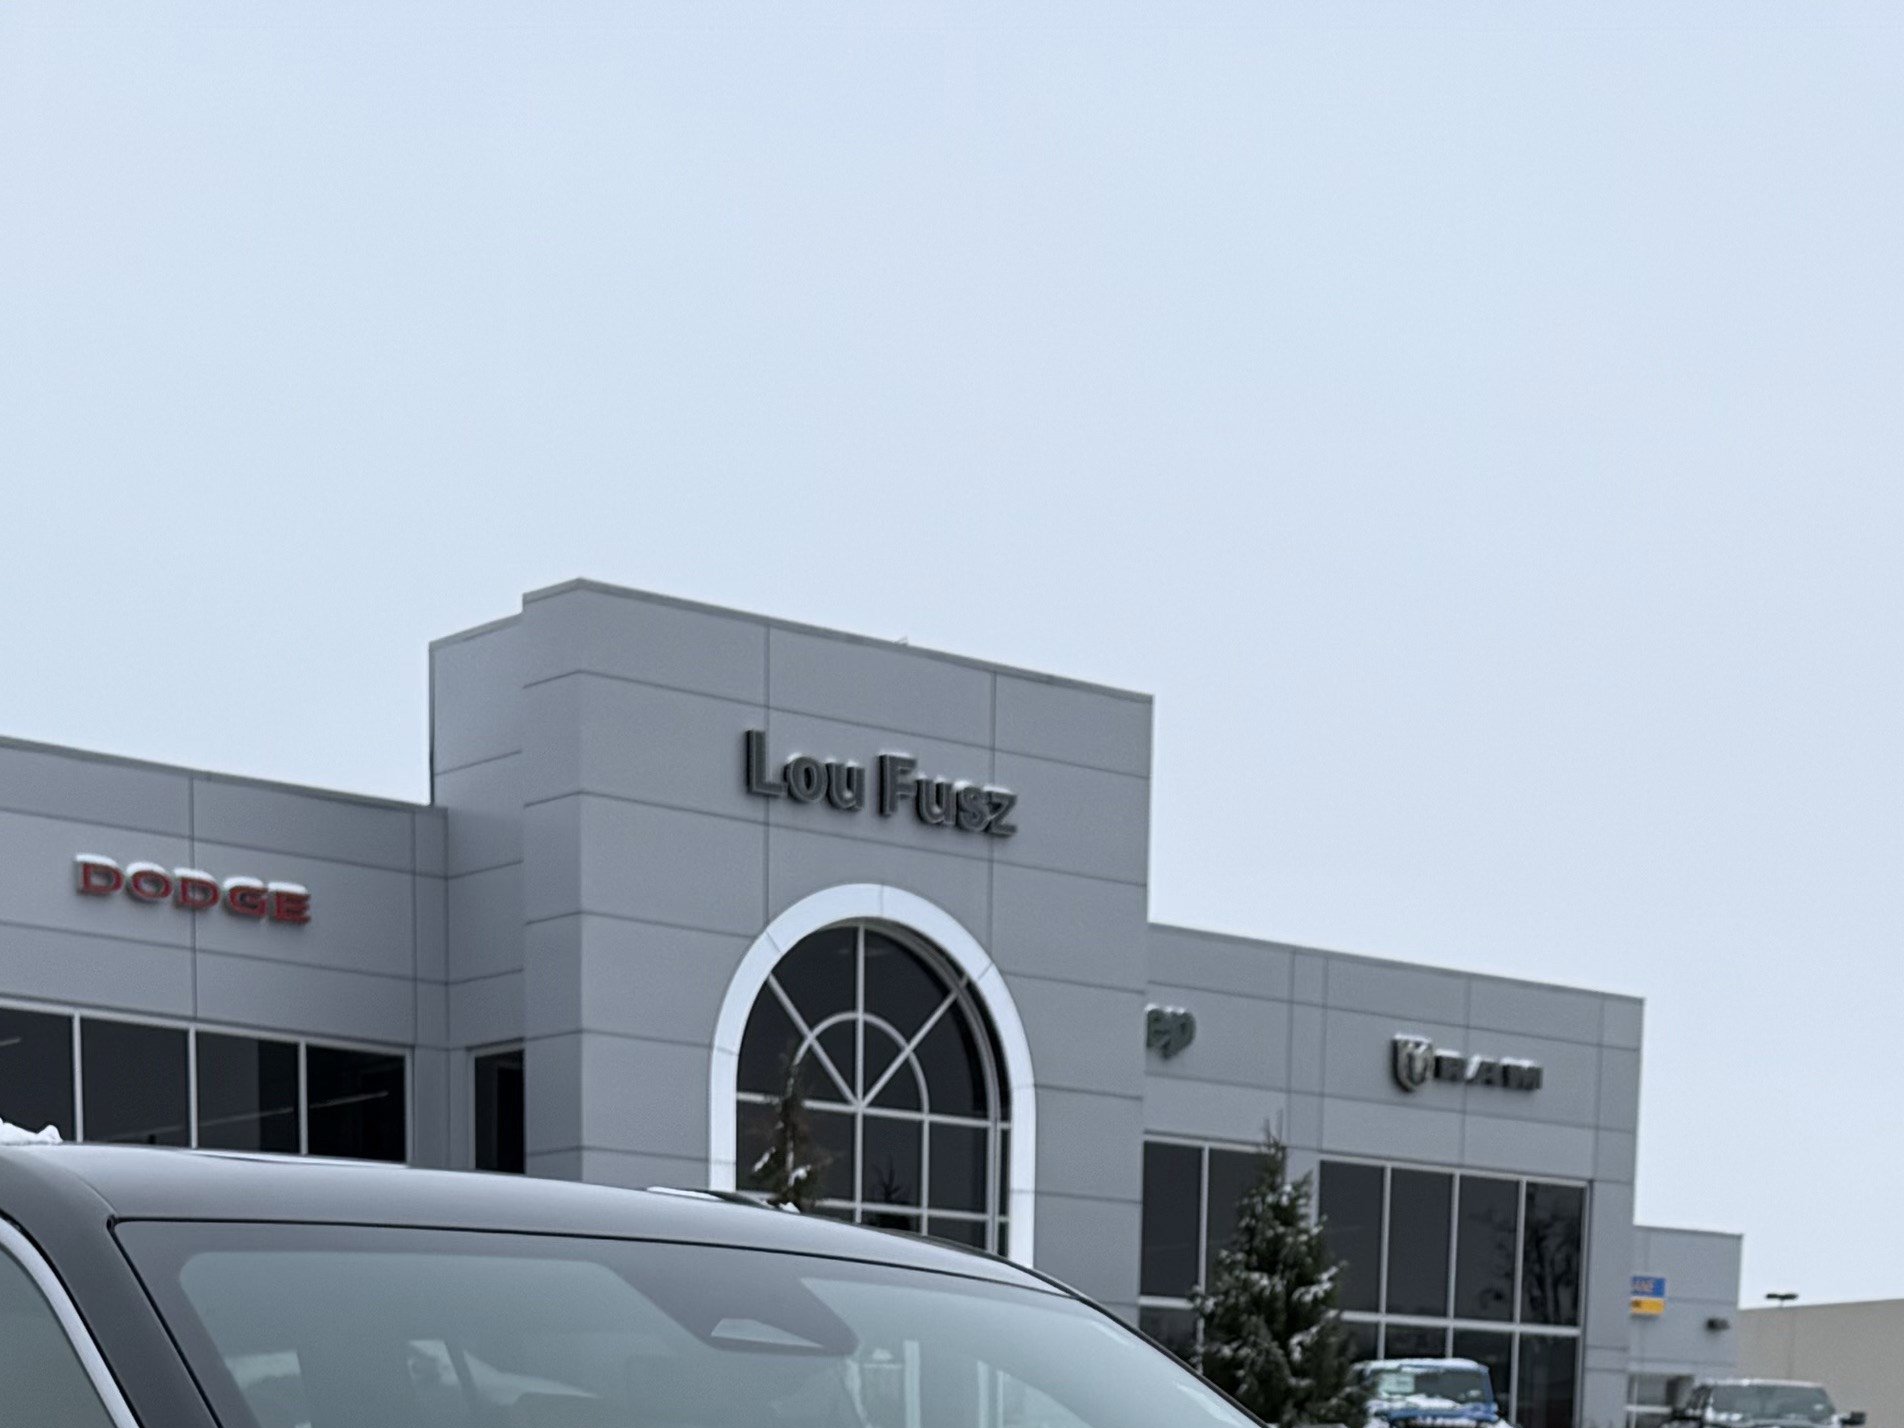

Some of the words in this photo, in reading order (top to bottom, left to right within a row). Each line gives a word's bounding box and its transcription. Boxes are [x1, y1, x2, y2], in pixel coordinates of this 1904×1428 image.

[745, 729, 864, 813] Lou
[877, 754, 1019, 838] Fusz
[75, 857, 312, 924] DODGE
